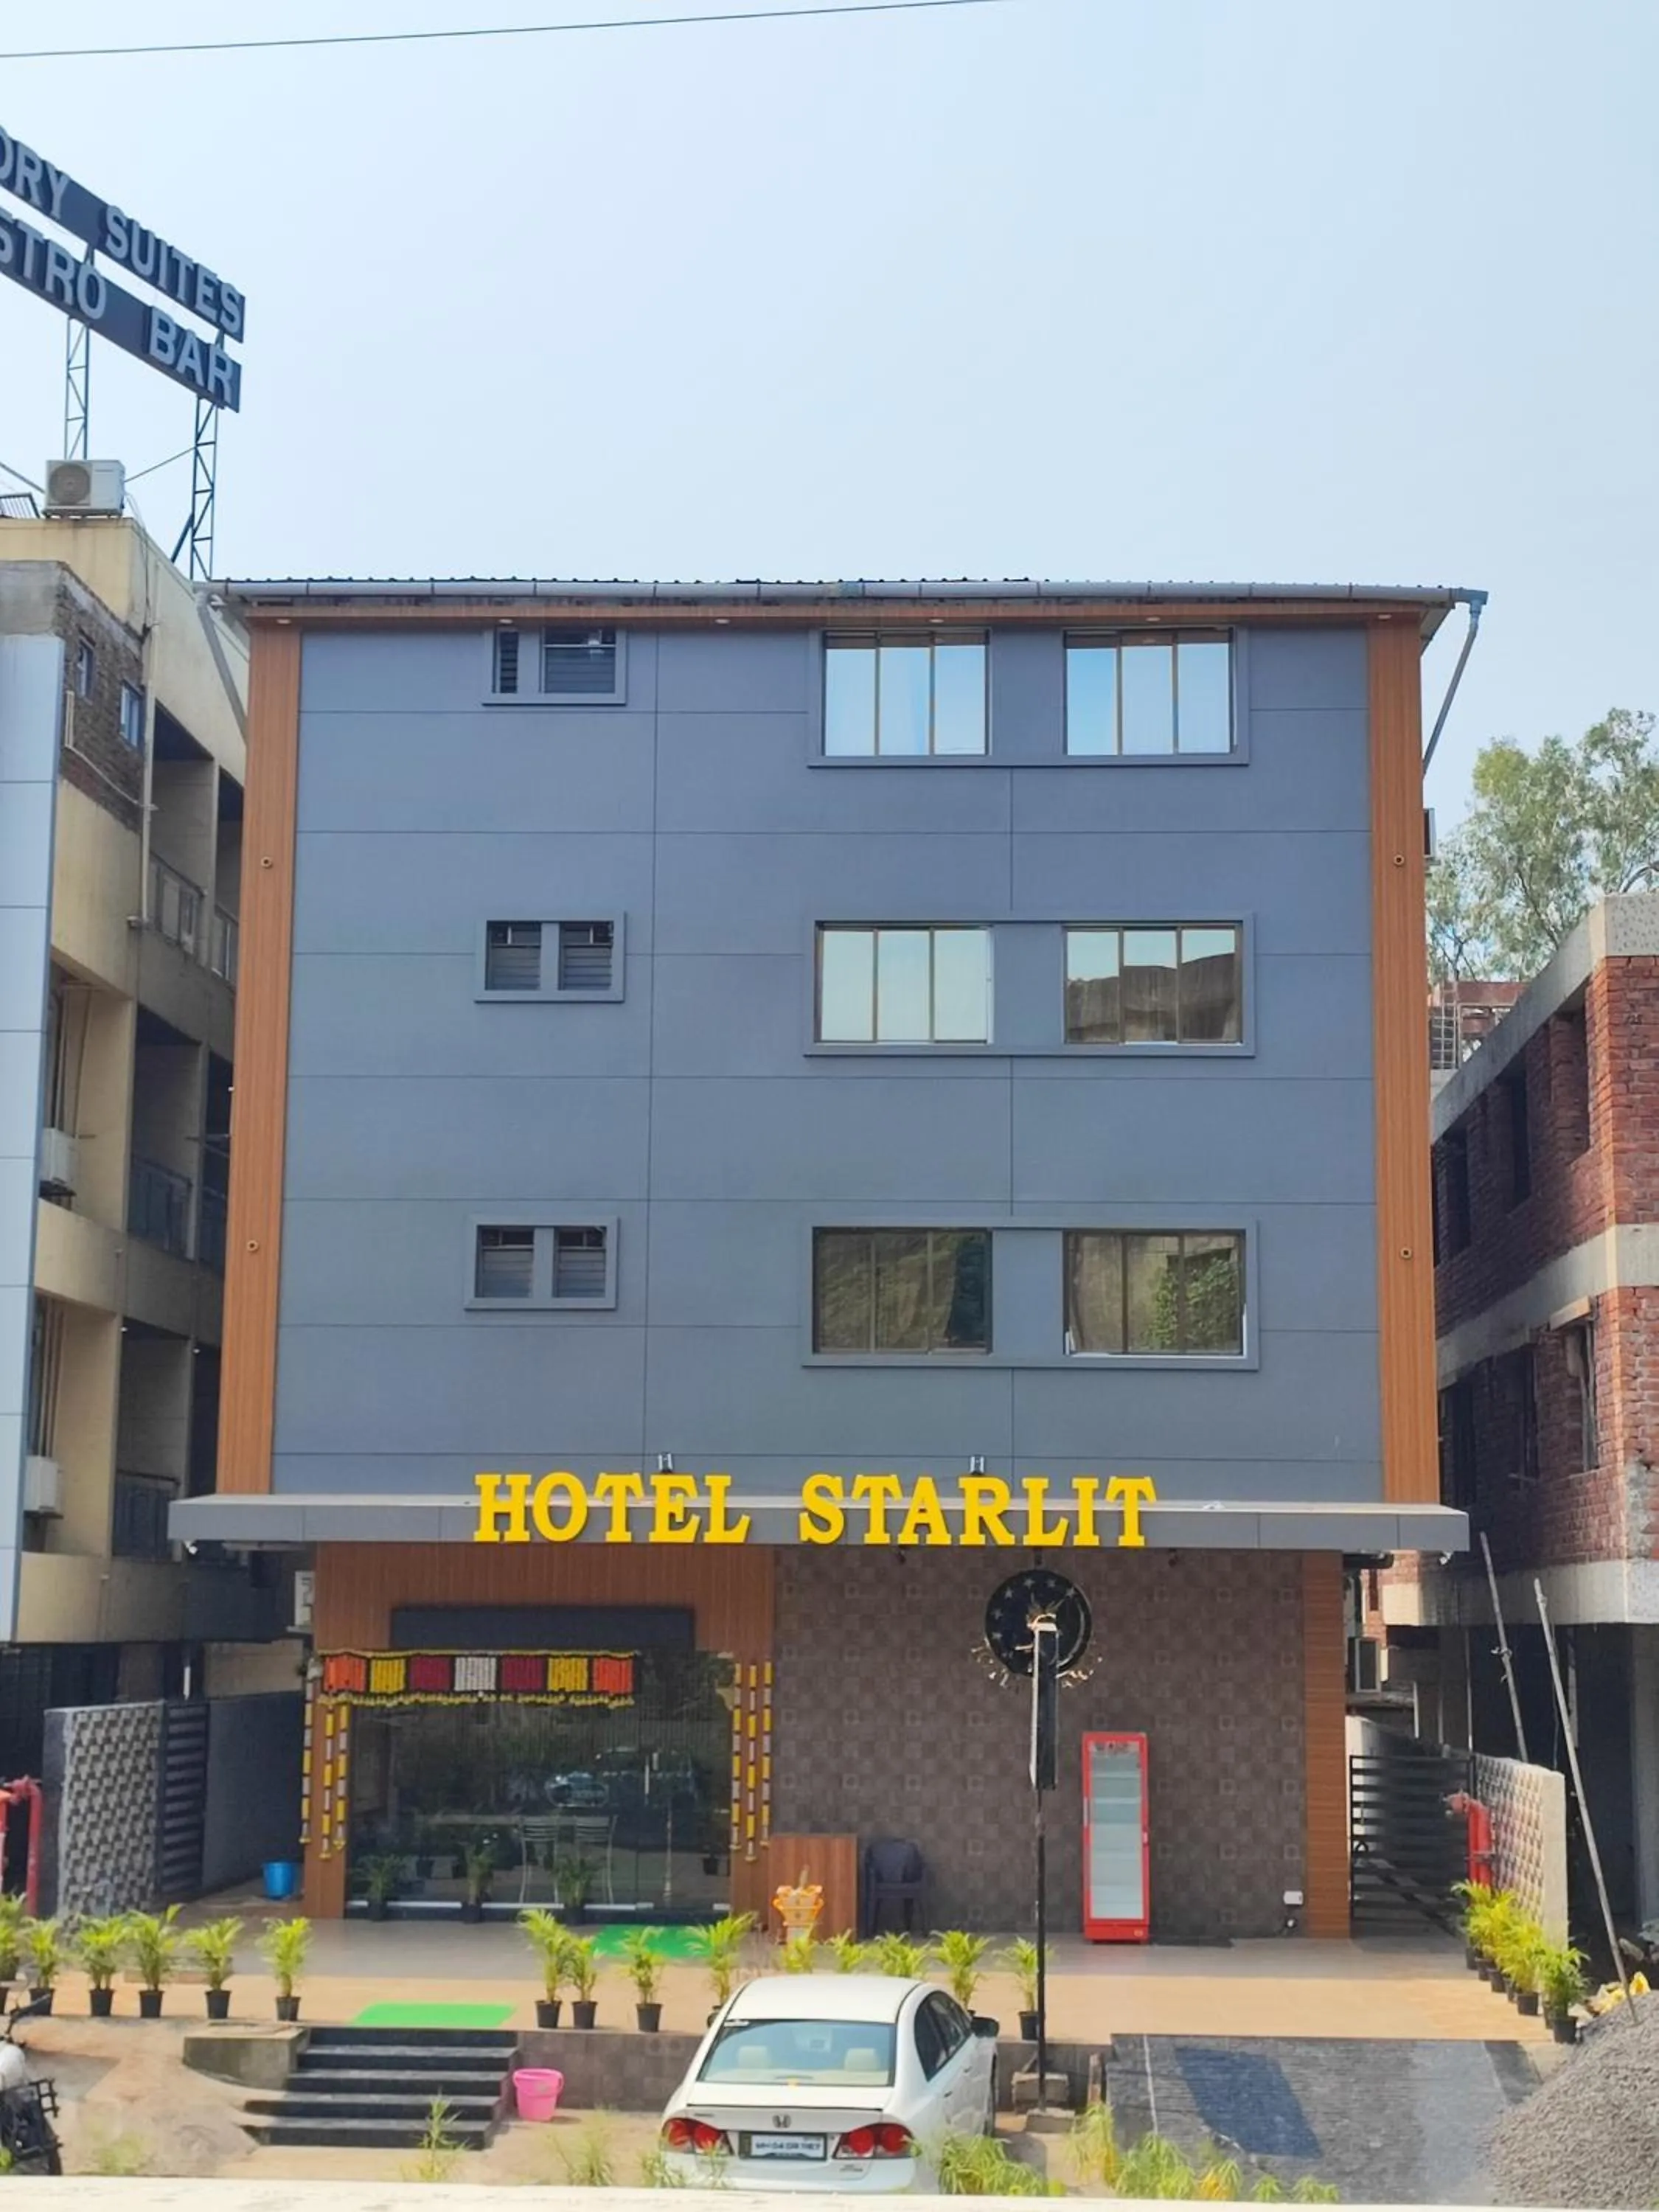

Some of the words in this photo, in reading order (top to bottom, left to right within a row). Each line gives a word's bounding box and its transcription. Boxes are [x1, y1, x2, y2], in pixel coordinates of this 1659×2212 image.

[105, 205, 241, 333] SUITES
[149, 305, 234, 405] BAR
[473, 1472, 751, 1545] HOTEL
[799, 1473, 1158, 1548] STARLIT
